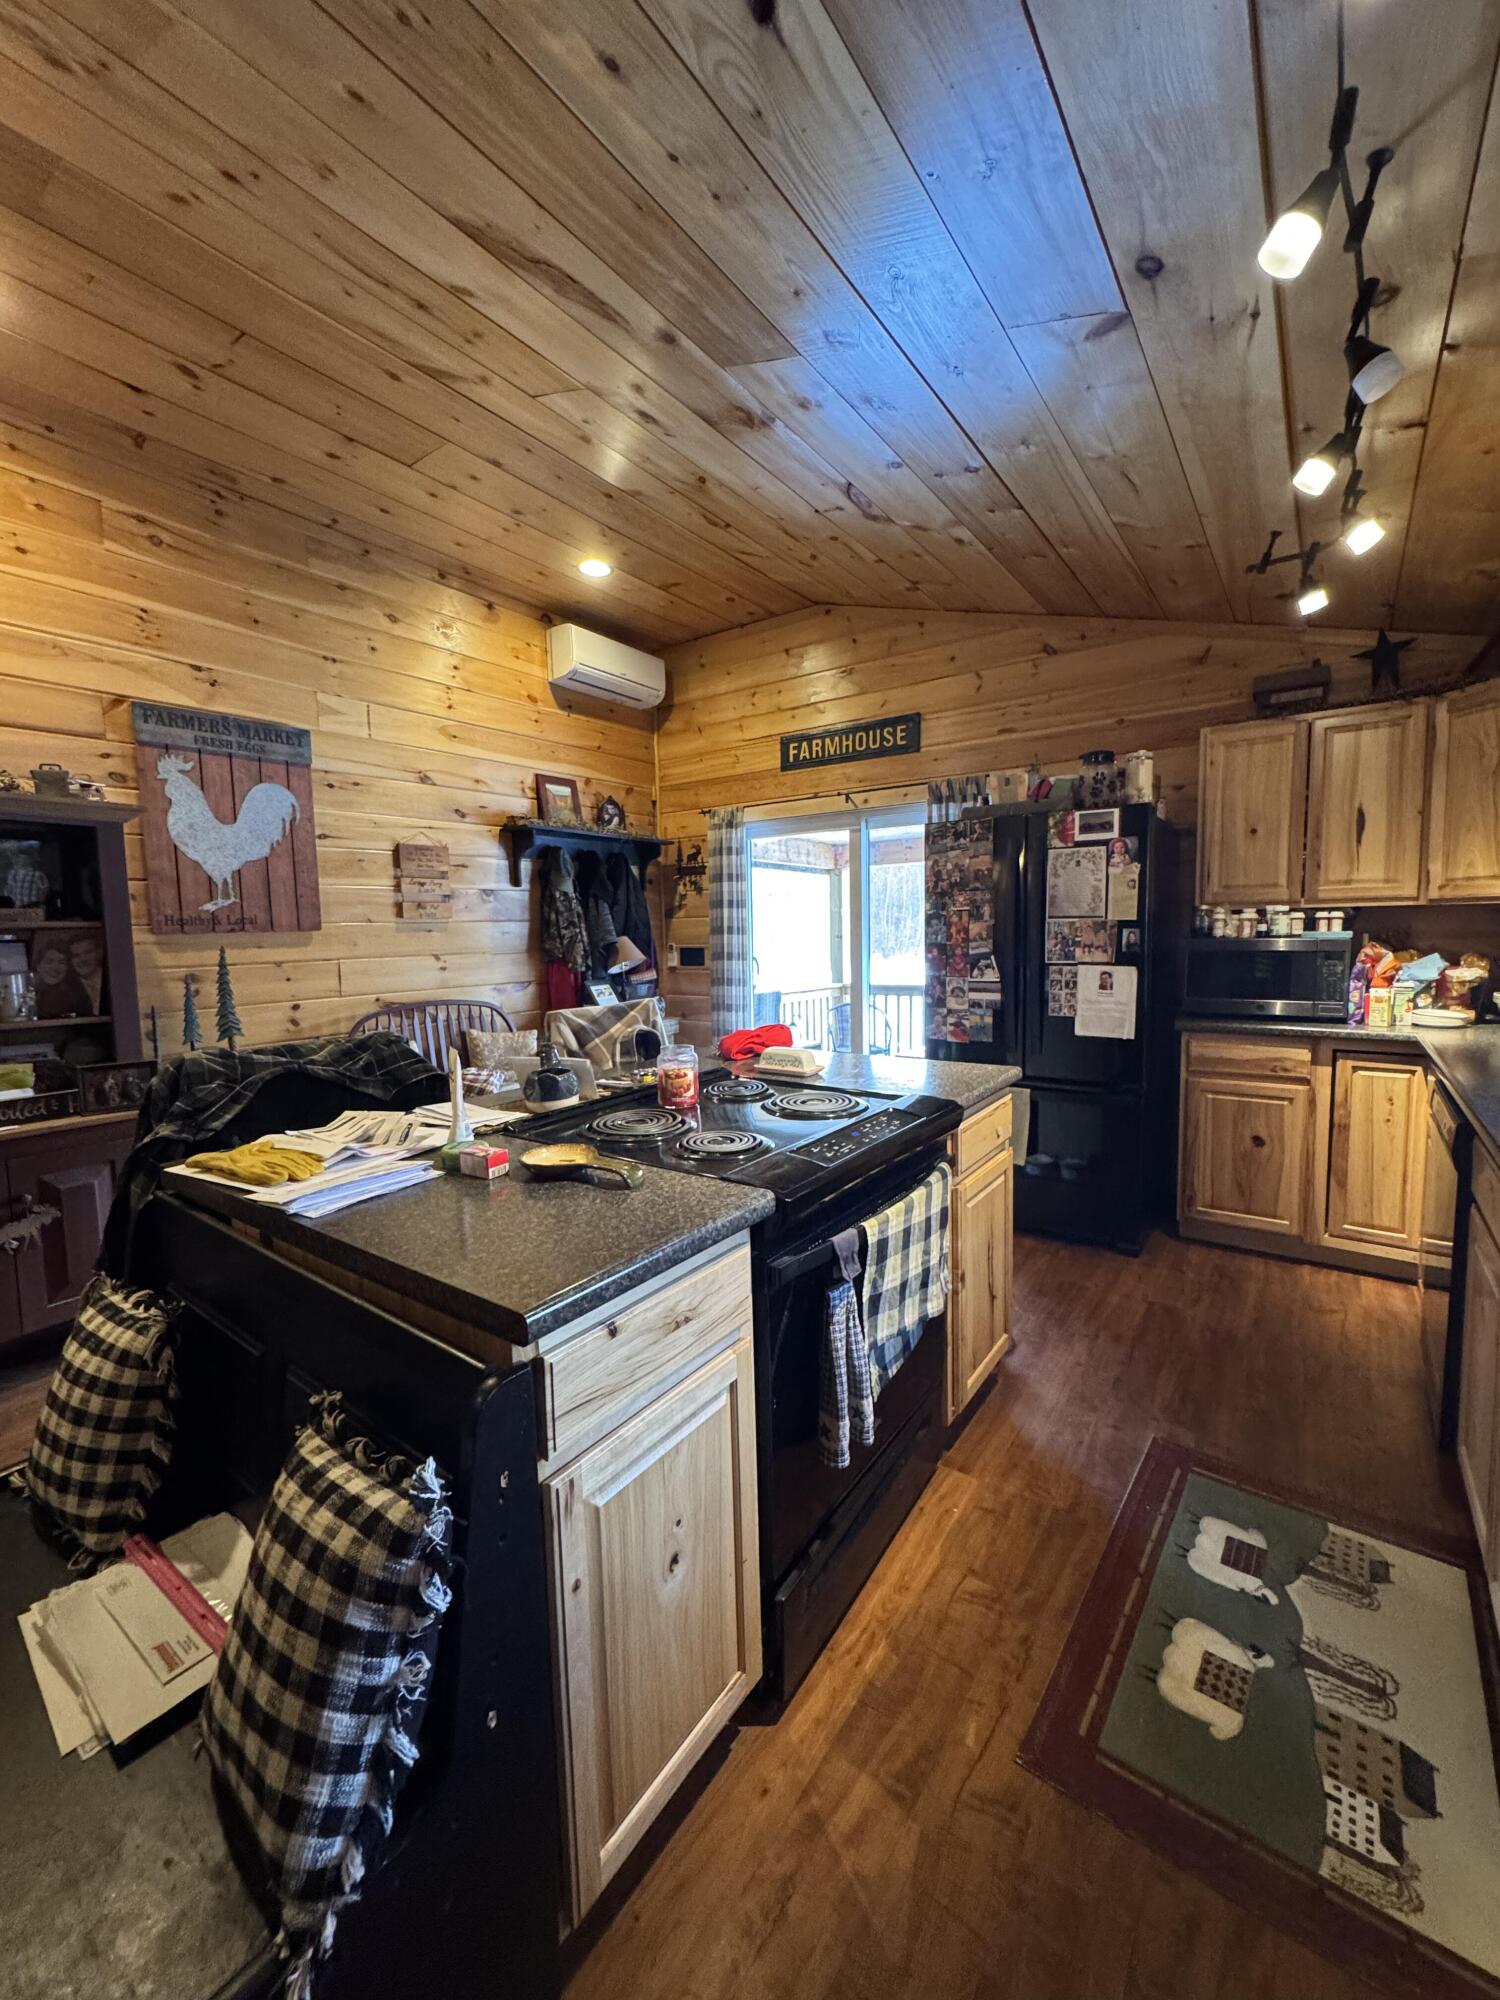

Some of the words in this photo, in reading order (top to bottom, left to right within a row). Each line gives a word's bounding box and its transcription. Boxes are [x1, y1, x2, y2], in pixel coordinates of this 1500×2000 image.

[193, 735, 234, 750] FRESH
[237, 741, 266, 754] EGGS
[237, 721, 305, 748] MARKET
[788, 724, 907, 763] FARMHOUSE
[226, 914, 258, 926] Local
